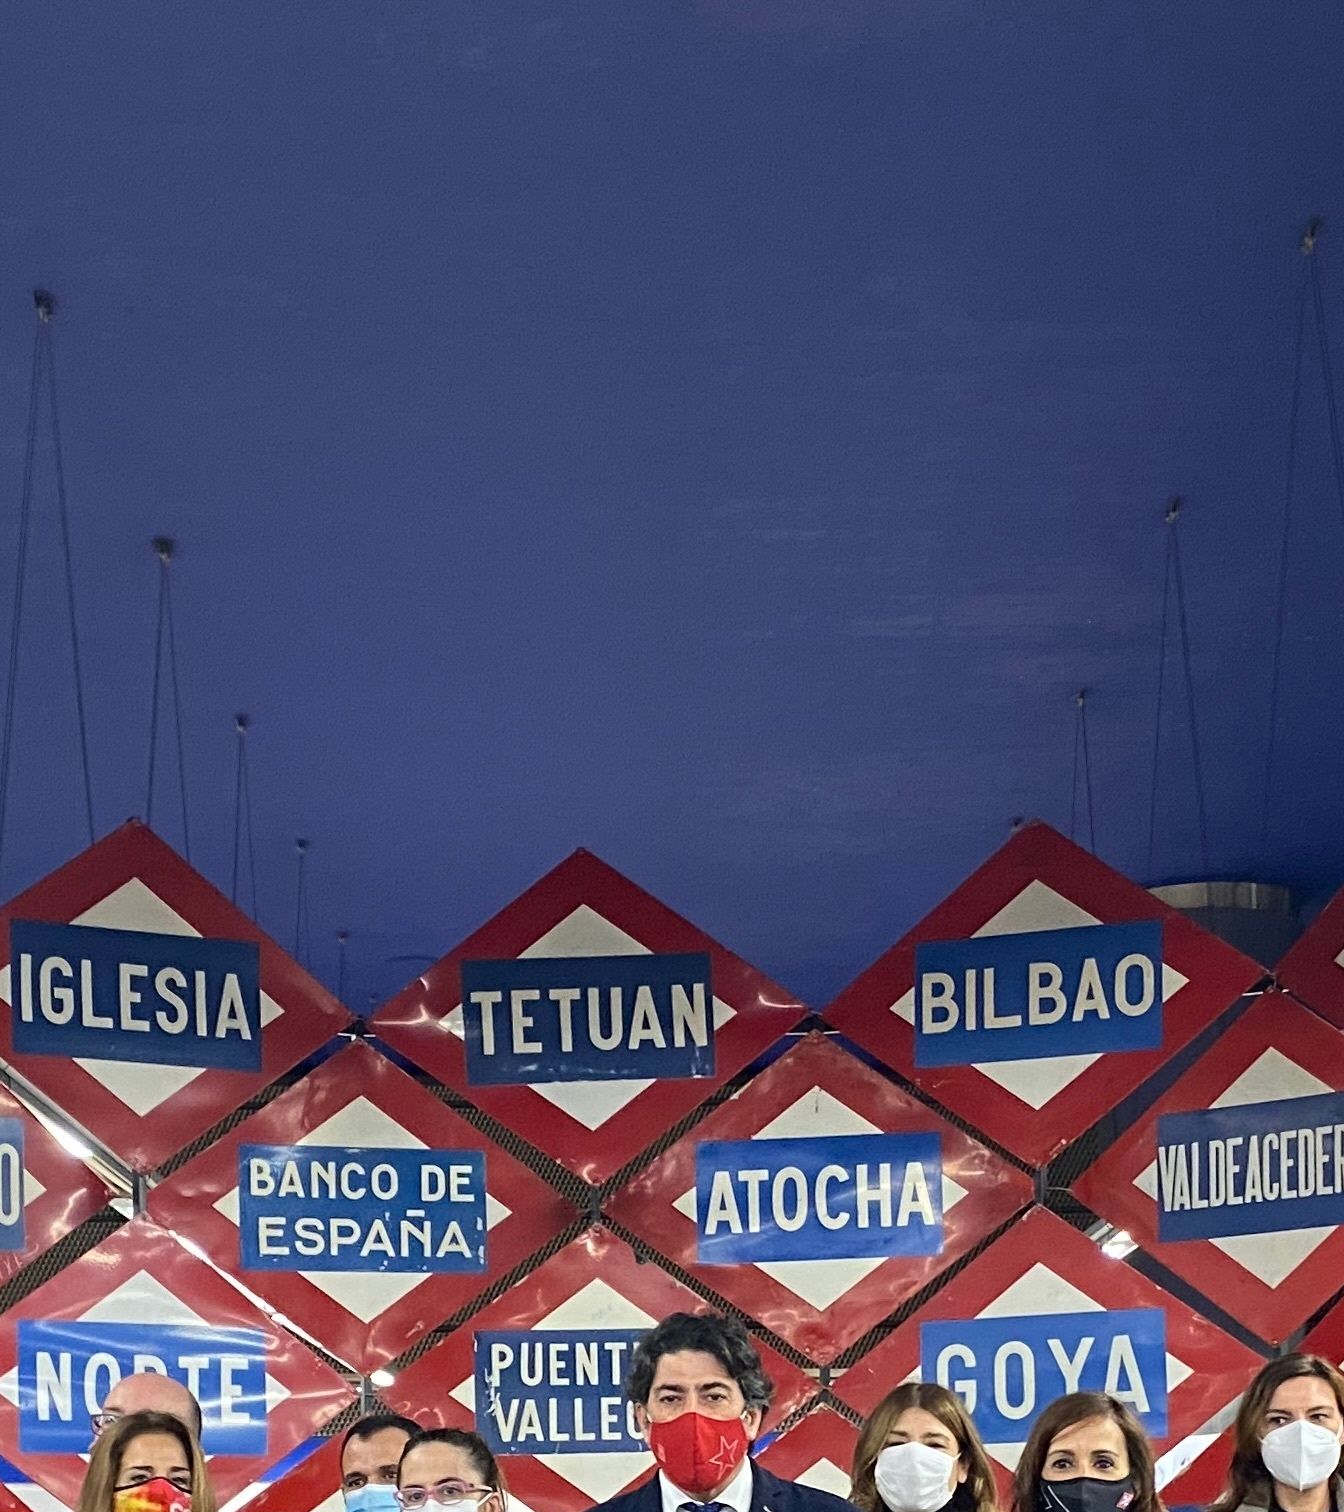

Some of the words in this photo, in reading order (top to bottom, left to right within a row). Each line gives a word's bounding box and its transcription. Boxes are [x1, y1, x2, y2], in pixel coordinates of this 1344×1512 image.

[19, 952, 253, 1041] IGLESIA
[469, 983, 709, 1056] TETUAN
[920, 953, 1156, 1035] BILBAO
[249, 1160, 399, 1200] BANCO
[420, 1163, 476, 1202] DE
[704, 1161, 936, 1235] ATOCHA
[258, 1208, 473, 1259] ESPAÑA
[489, 1341, 642, 1388] PUENT
[936, 1333, 1151, 1421] GOYA
